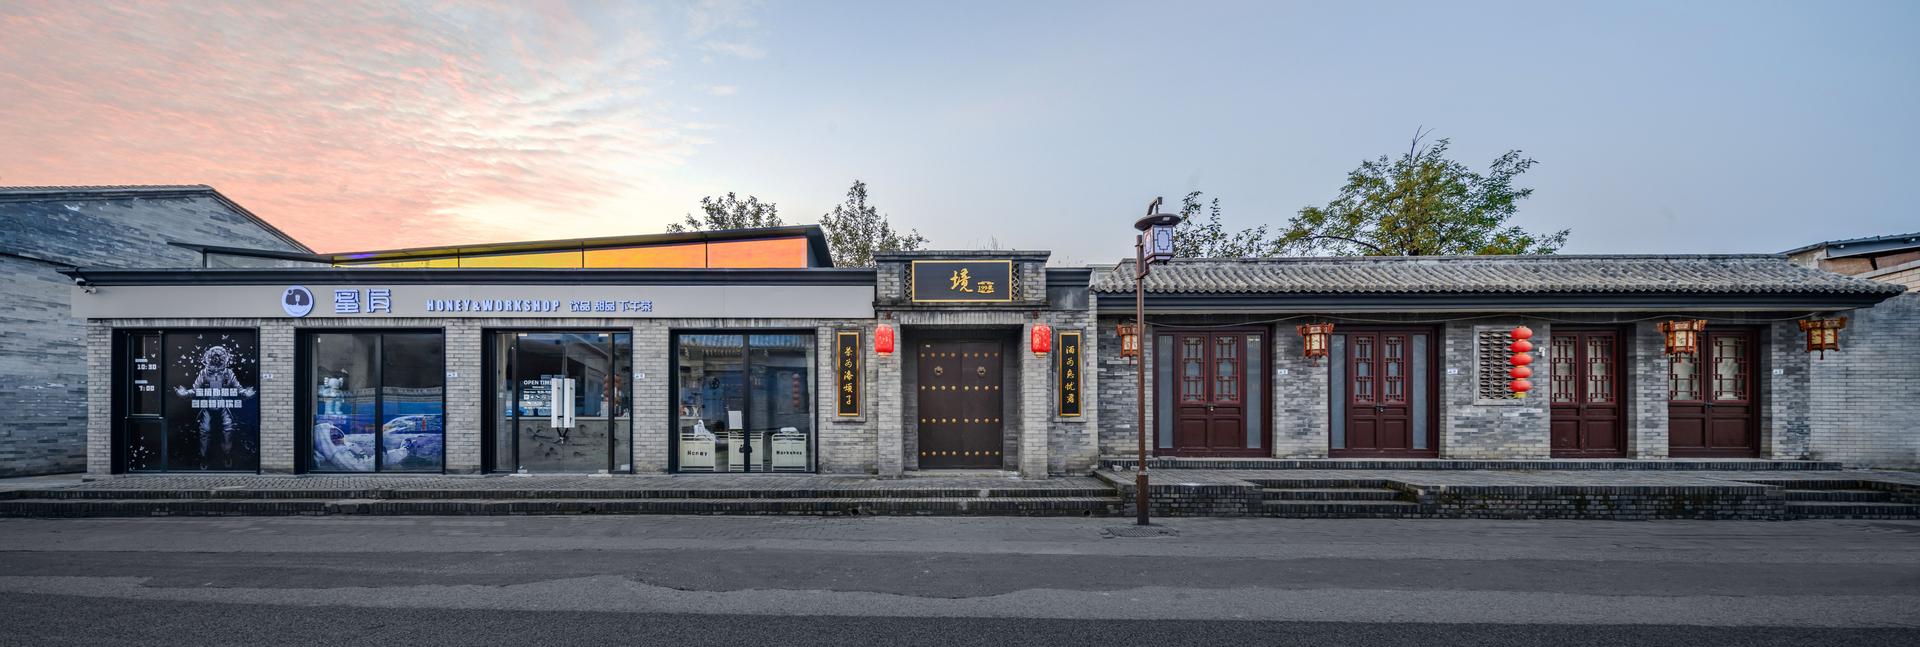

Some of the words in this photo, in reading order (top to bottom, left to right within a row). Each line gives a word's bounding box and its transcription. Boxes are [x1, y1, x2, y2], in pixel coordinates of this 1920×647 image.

[426, 299, 561, 313] HONEY&WORKSHOP
[569, 300, 592, 313] 饮品
[594, 300, 617, 313] 甜品
[618, 300, 654, 313] 下午茶
